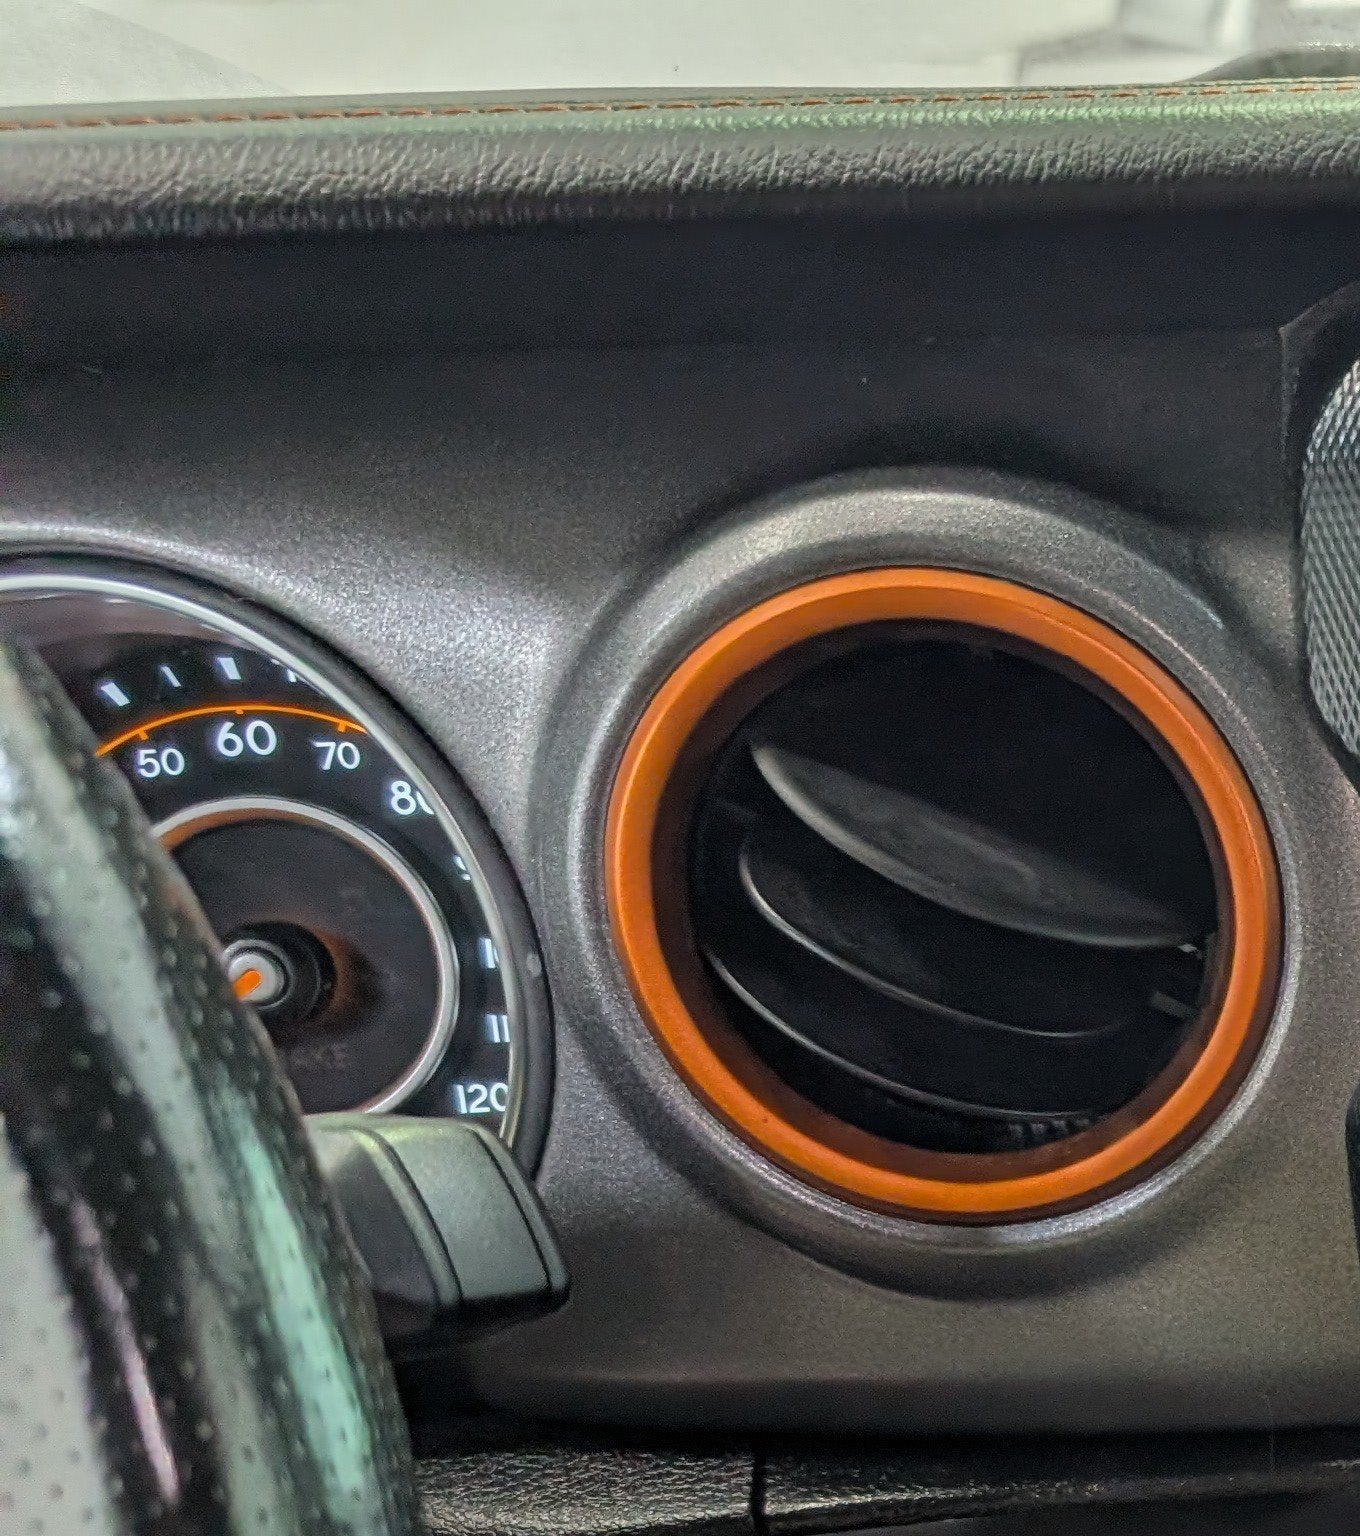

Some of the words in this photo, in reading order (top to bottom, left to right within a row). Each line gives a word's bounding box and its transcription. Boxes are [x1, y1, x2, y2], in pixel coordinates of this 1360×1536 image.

[217, 720, 277, 757] 60
[137, 748, 185, 778] 50
[314, 741, 361, 771] 70
[455, 1082, 509, 1114] 120
